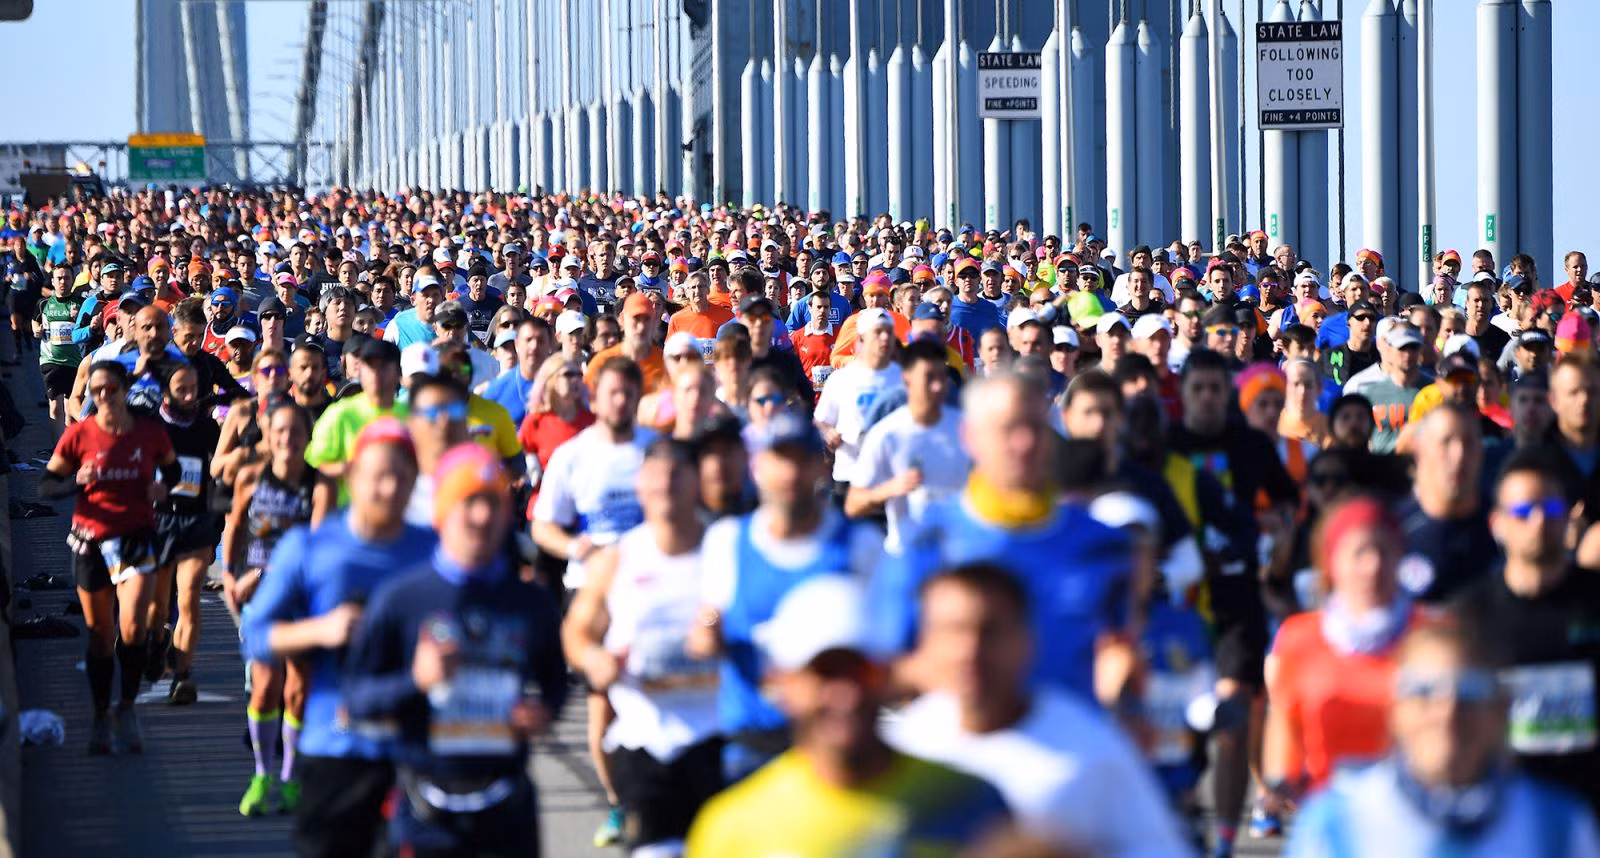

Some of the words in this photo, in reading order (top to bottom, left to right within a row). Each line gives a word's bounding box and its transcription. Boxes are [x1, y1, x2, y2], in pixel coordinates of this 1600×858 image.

[1259, 25, 1302, 38] STATE
[1310, 24, 1339, 37] LAW
[979, 54, 1012, 67] STATE
[1260, 48, 1339, 61] FOLLOWING
[1287, 68, 1313, 80] TOO
[985, 77, 1038, 89] SPEEDING
[1269, 87, 1331, 101] CLOSELY
[1264, 112, 1284, 122] FINE
[1305, 111, 1338, 121] POINTS
